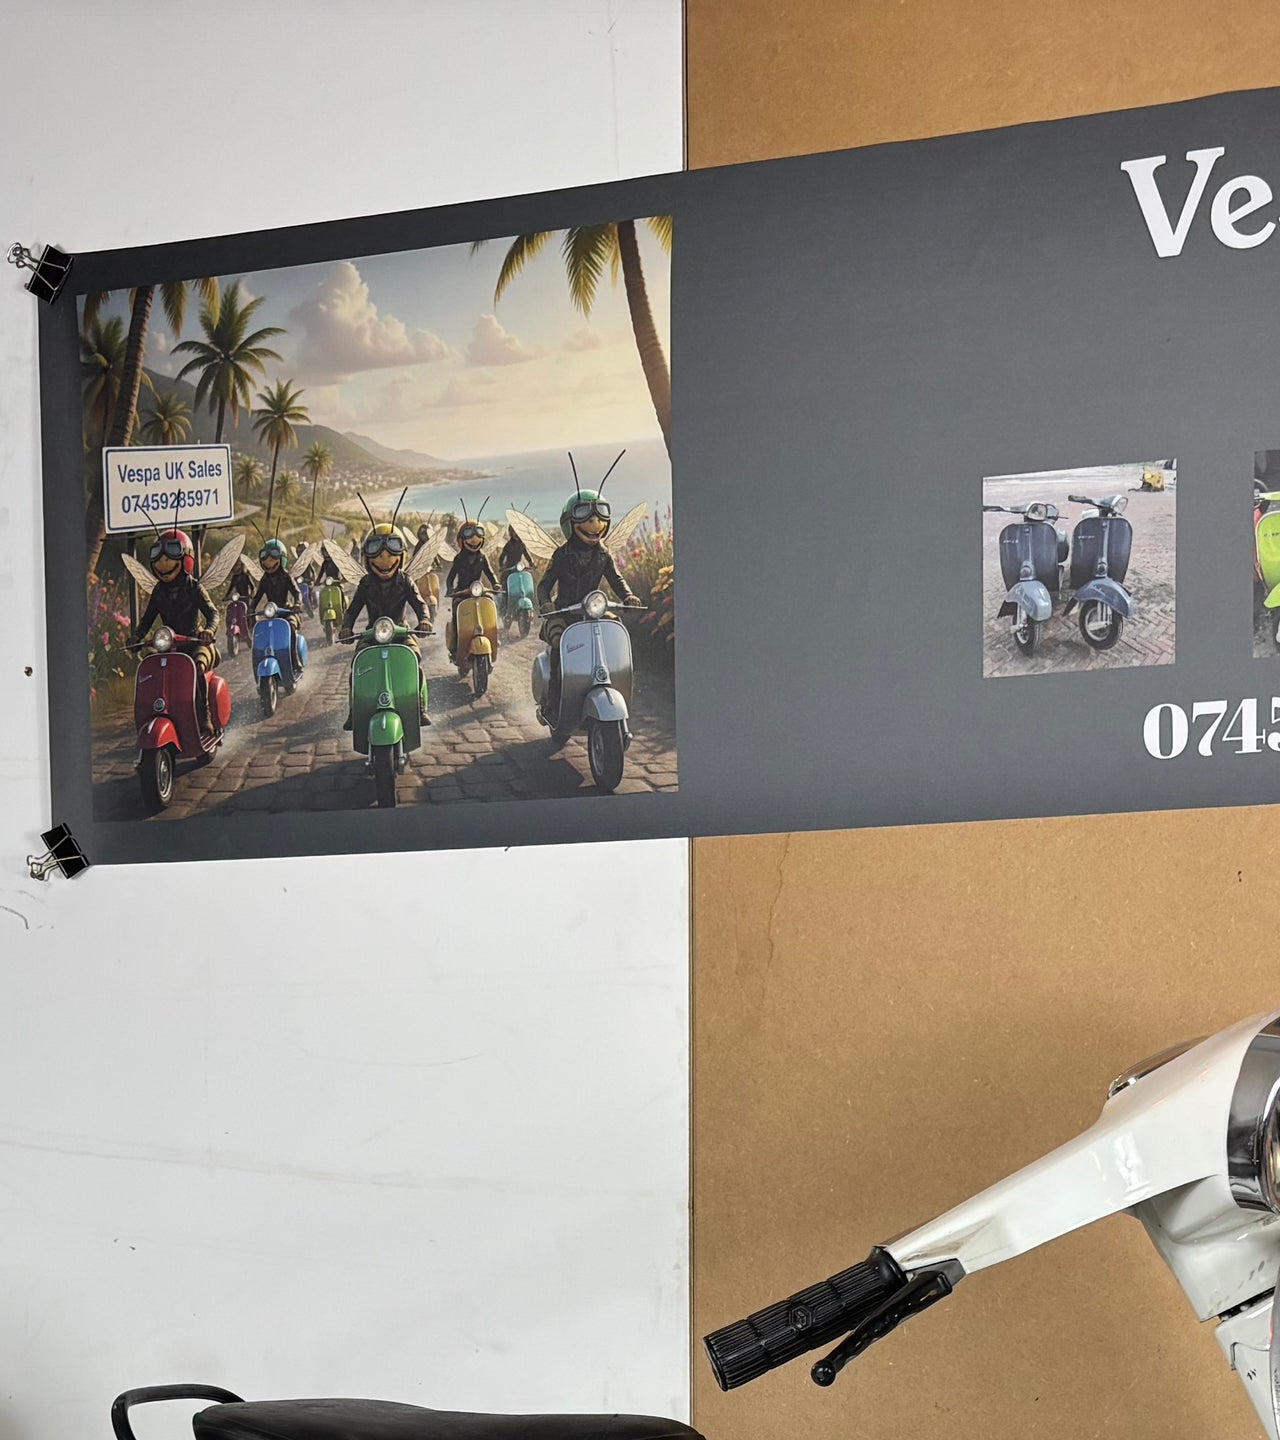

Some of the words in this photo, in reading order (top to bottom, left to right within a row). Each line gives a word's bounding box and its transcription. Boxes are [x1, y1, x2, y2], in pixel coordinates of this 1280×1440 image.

[118, 464, 160, 486] Vespa
[165, 461, 184, 480] UK
[188, 460, 222, 478] Sales
[122, 488, 218, 513] 07459285971
